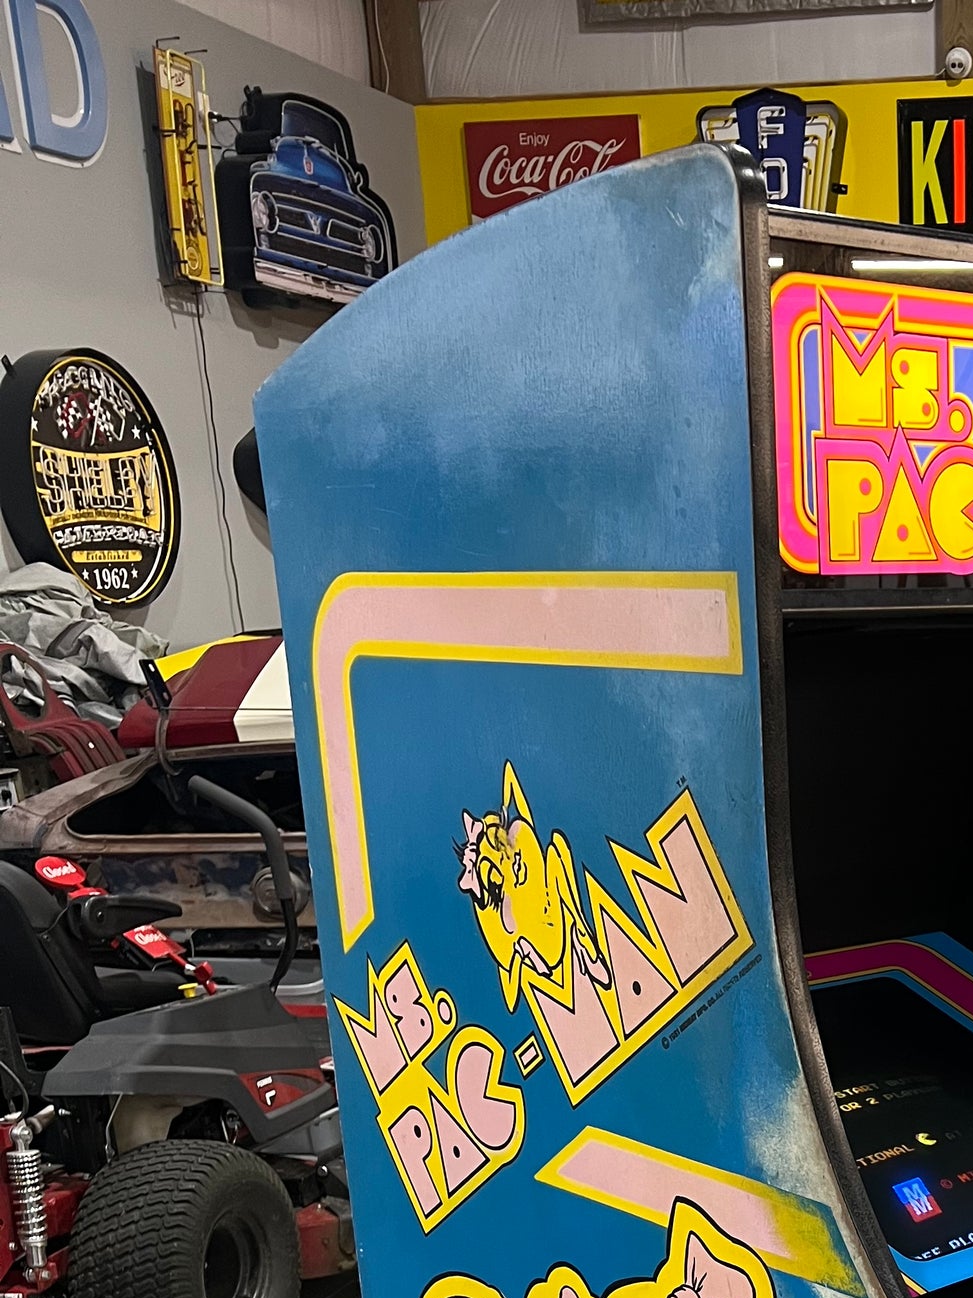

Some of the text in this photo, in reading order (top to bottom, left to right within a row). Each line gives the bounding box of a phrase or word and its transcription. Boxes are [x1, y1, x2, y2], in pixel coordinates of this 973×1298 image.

[519, 132, 550, 147] Enjoy
[479, 137, 627, 198] Coca-Col
[41, 446, 157, 516] SHELBY
[94, 568, 130, 589] 1962
[42, 861, 77, 879] Closed
[834, 1083, 880, 1099] START
[840, 1102, 862, 1112] OR
[866, 1097, 879, 1105] 2
[857, 1145, 915, 1169] TIONAL
